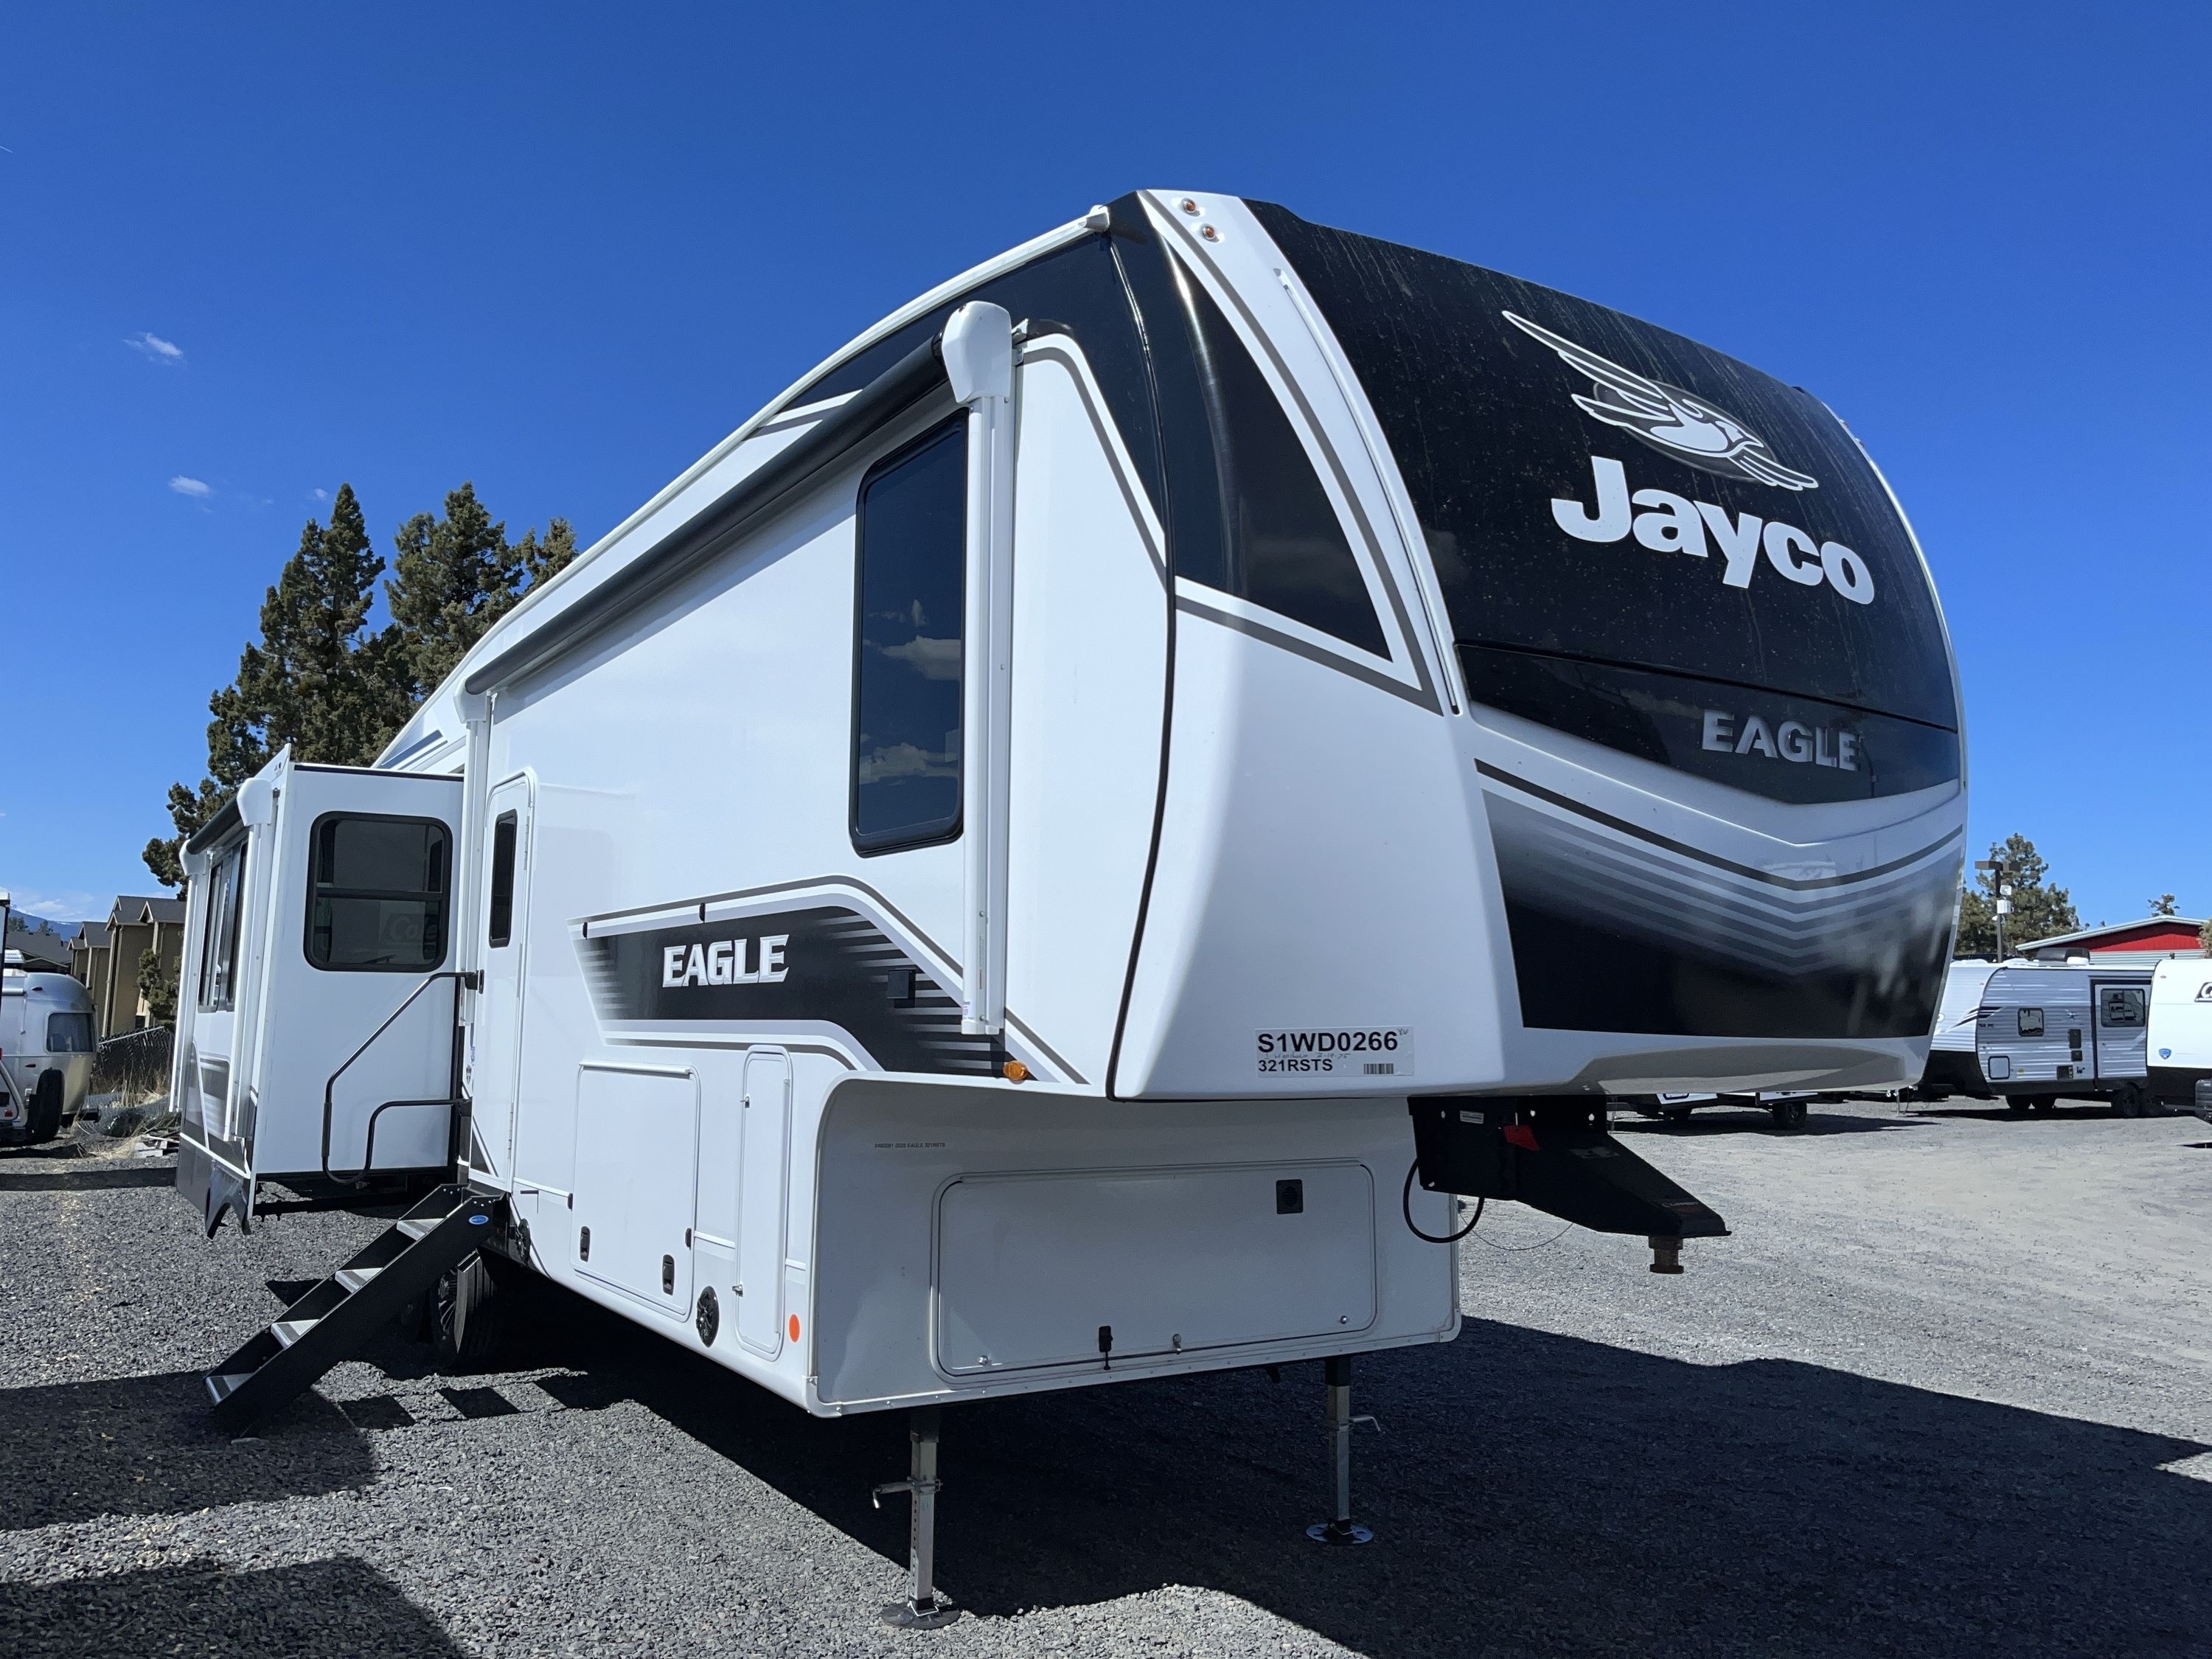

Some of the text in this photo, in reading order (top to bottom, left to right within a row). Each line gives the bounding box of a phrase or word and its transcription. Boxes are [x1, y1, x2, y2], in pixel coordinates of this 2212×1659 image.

[1551, 455, 1874, 605] Jayco
[1702, 709, 1861, 771] EAGLE
[662, 934, 789, 988] EAGLE
[1258, 1031, 1398, 1053] S1WD0266
[1258, 1059, 1333, 1072] 321RSTS
